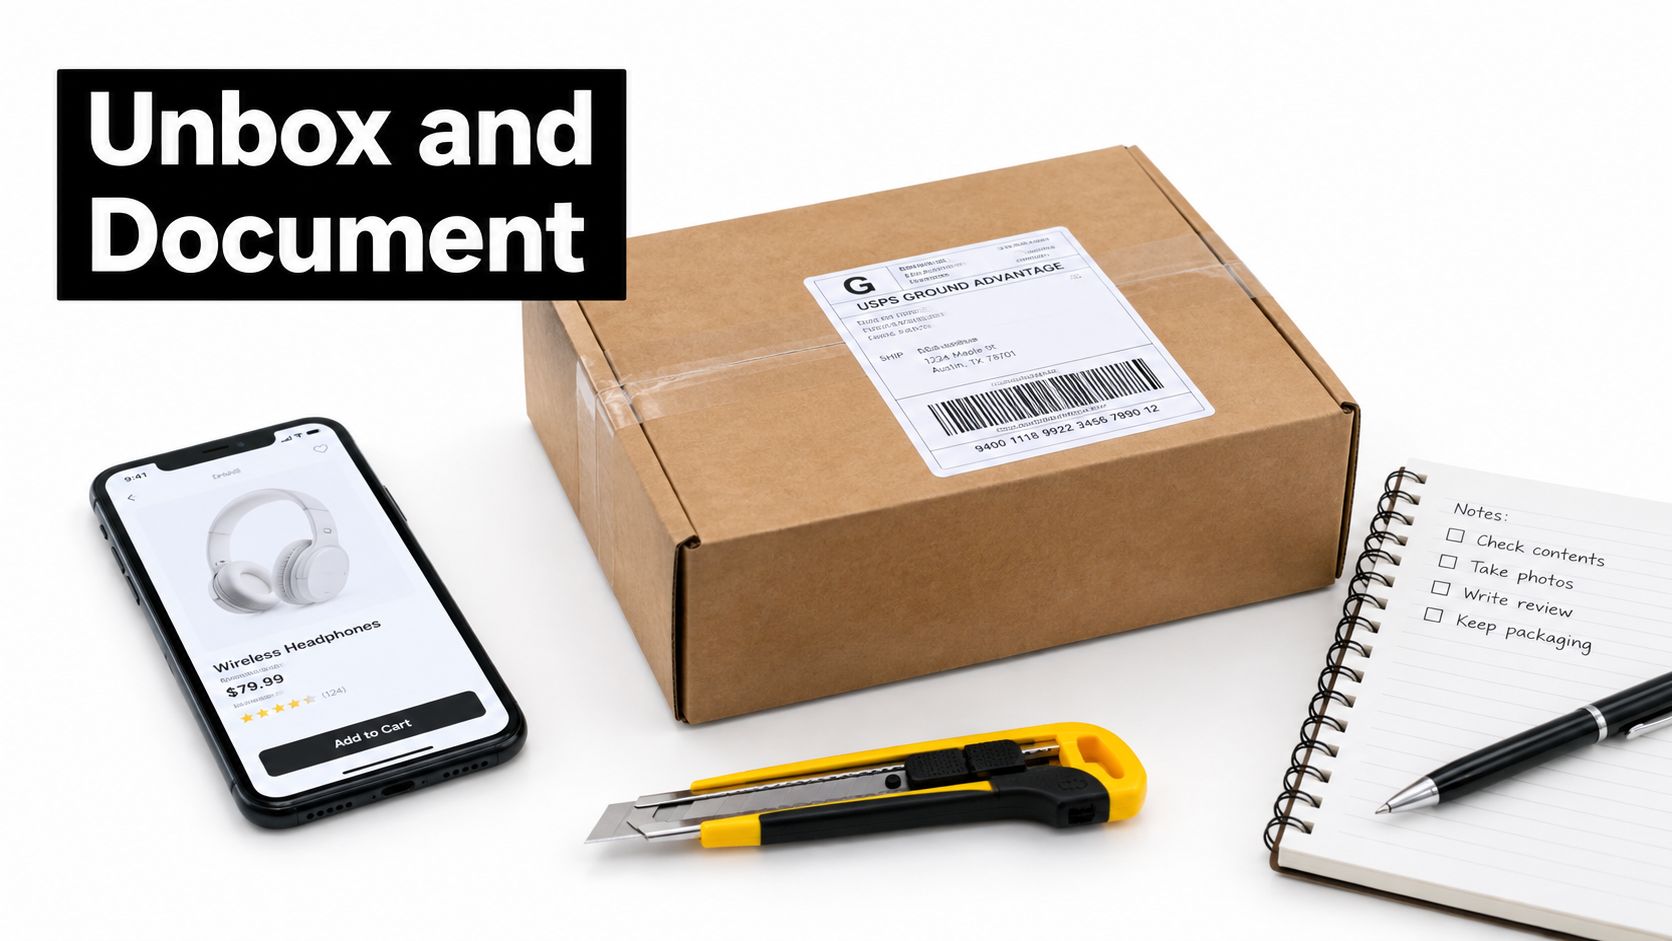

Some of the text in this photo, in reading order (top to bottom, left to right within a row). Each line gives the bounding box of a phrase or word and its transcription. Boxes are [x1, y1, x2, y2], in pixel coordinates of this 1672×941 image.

[843, 276, 876, 295] G
[856, 295, 900, 312] USPS
[903, 281, 970, 303] GROUND
[974, 261, 1065, 288] ADVANTAGE
[880, 351, 904, 362] SHIP
[969, 358, 985, 366] TX
[986, 350, 1017, 362] 78701
[975, 440, 1007, 453] 9400
[1010, 432, 1040, 444] 1118
[1042, 423, 1075, 437] 9922
[1076, 416, 1108, 429] 3456
[1144, 404, 1160, 414] 12
[124, 472, 148, 483] 9:41
[1453, 502, 1509, 522] Notes:
[1476, 534, 1605, 567] Check contents
[1470, 559, 1574, 590] Take photos
[1463, 587, 1573, 618] Write review
[213, 648, 282, 674] Wireless
[284, 618, 382, 654] Headphones
[1456, 613, 1592, 656] Keep packaging
[226, 674, 285, 698] $79.99
[321, 686, 347, 699] (124)
[334, 718, 413, 749] Add to Cart
